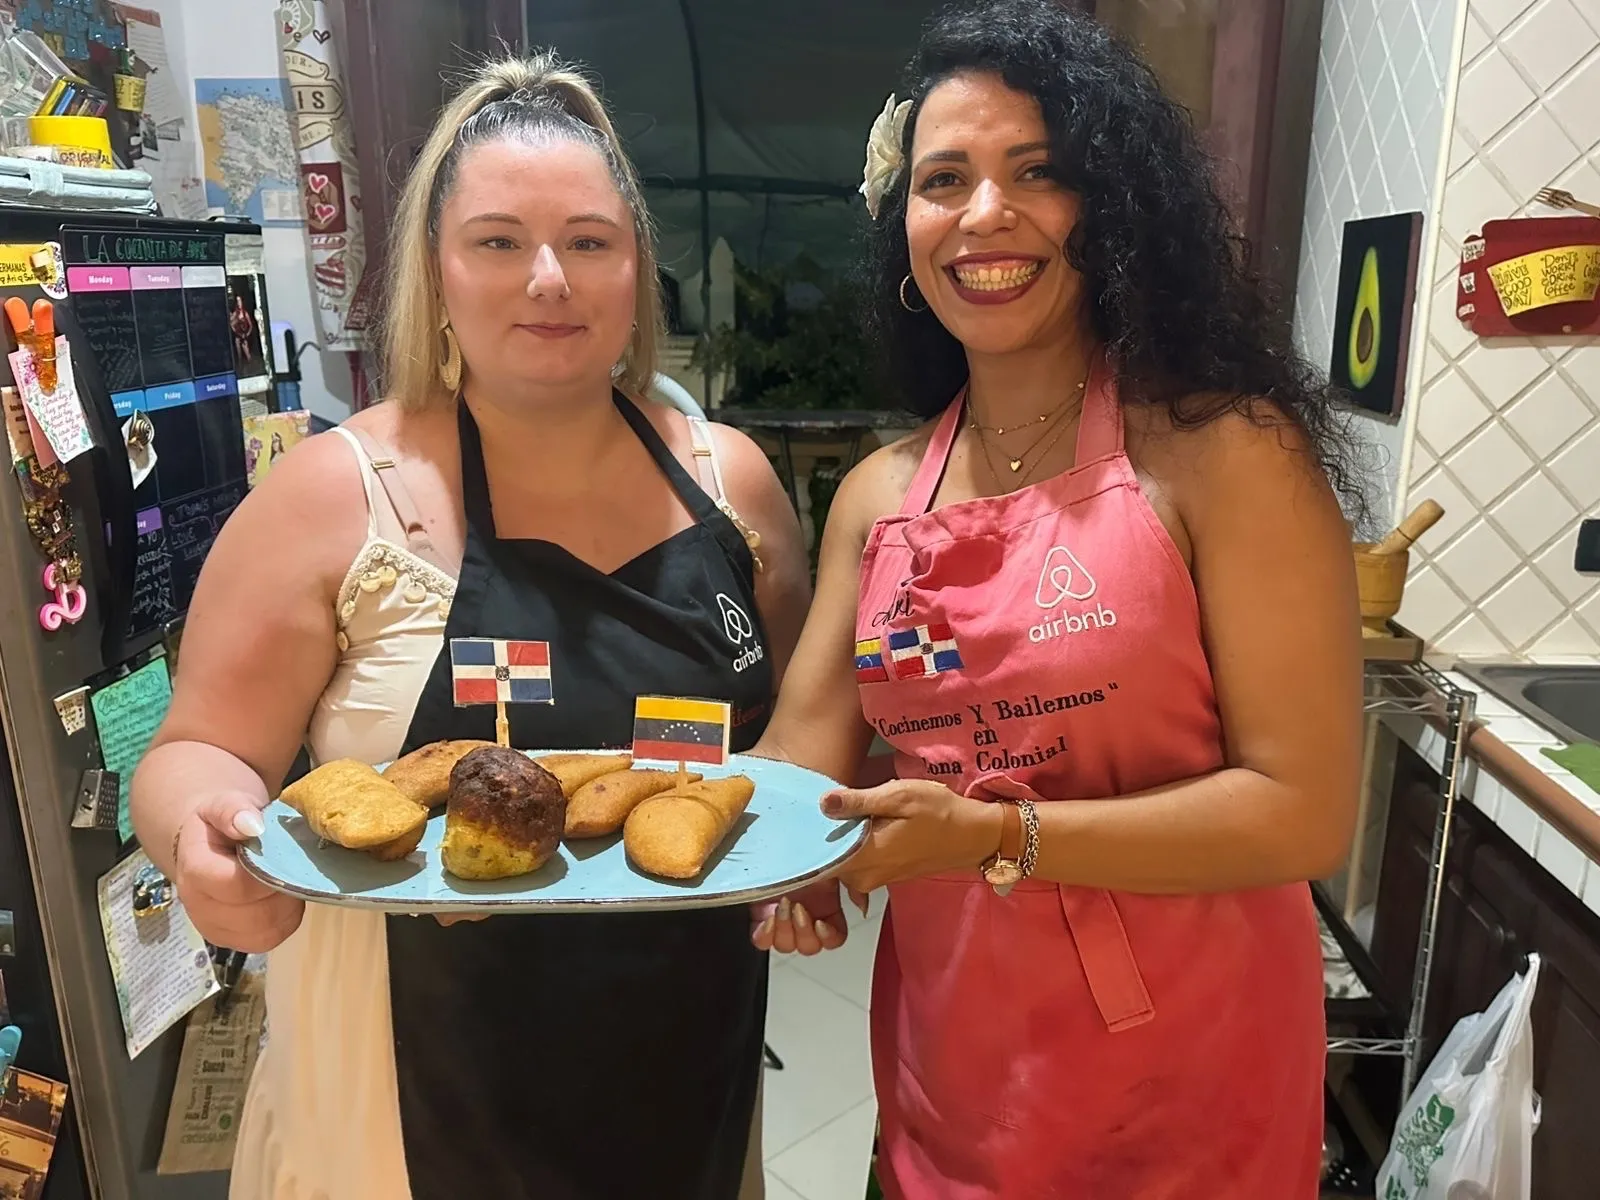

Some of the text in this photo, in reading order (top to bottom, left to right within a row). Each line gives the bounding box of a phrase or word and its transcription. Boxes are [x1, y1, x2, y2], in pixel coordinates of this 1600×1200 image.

[89, 275, 113, 285] Monday
[148, 274, 170, 283] Tuesday
[164, 391, 182, 400] Friday
[1029, 602, 1117, 643] airbnb
[733, 640, 764, 673] airbnb
[966, 704, 985, 724] Y
[973, 728, 999, 747] en
[921, 736, 1068, 775] ona Colonial
